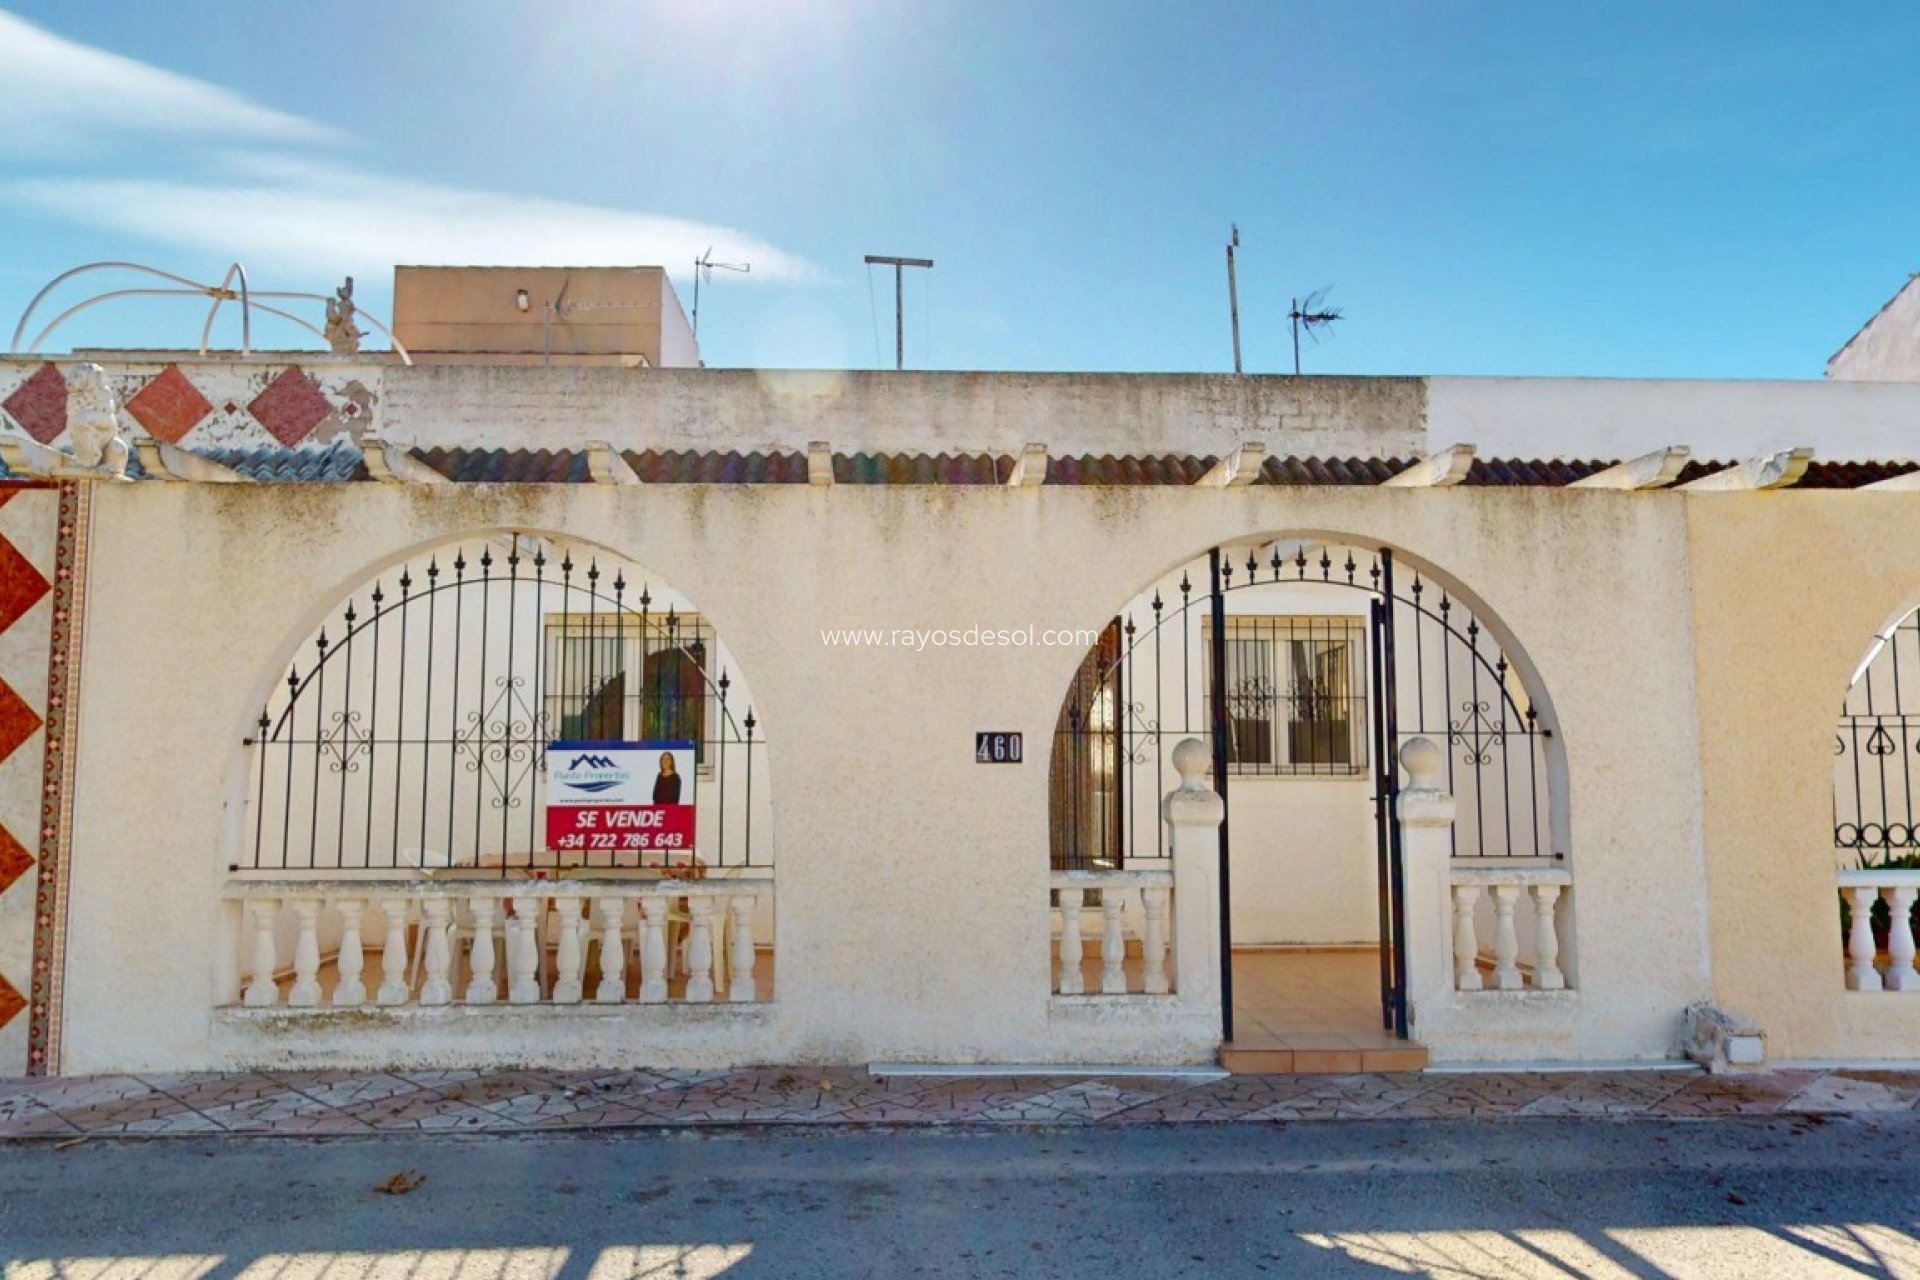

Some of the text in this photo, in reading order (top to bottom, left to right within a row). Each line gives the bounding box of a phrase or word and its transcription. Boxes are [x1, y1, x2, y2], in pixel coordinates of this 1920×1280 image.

[977, 734, 1020, 760] 460
[576, 810, 665, 828] SE VENDE
[558, 833, 683, 848] +34 722 786 643
